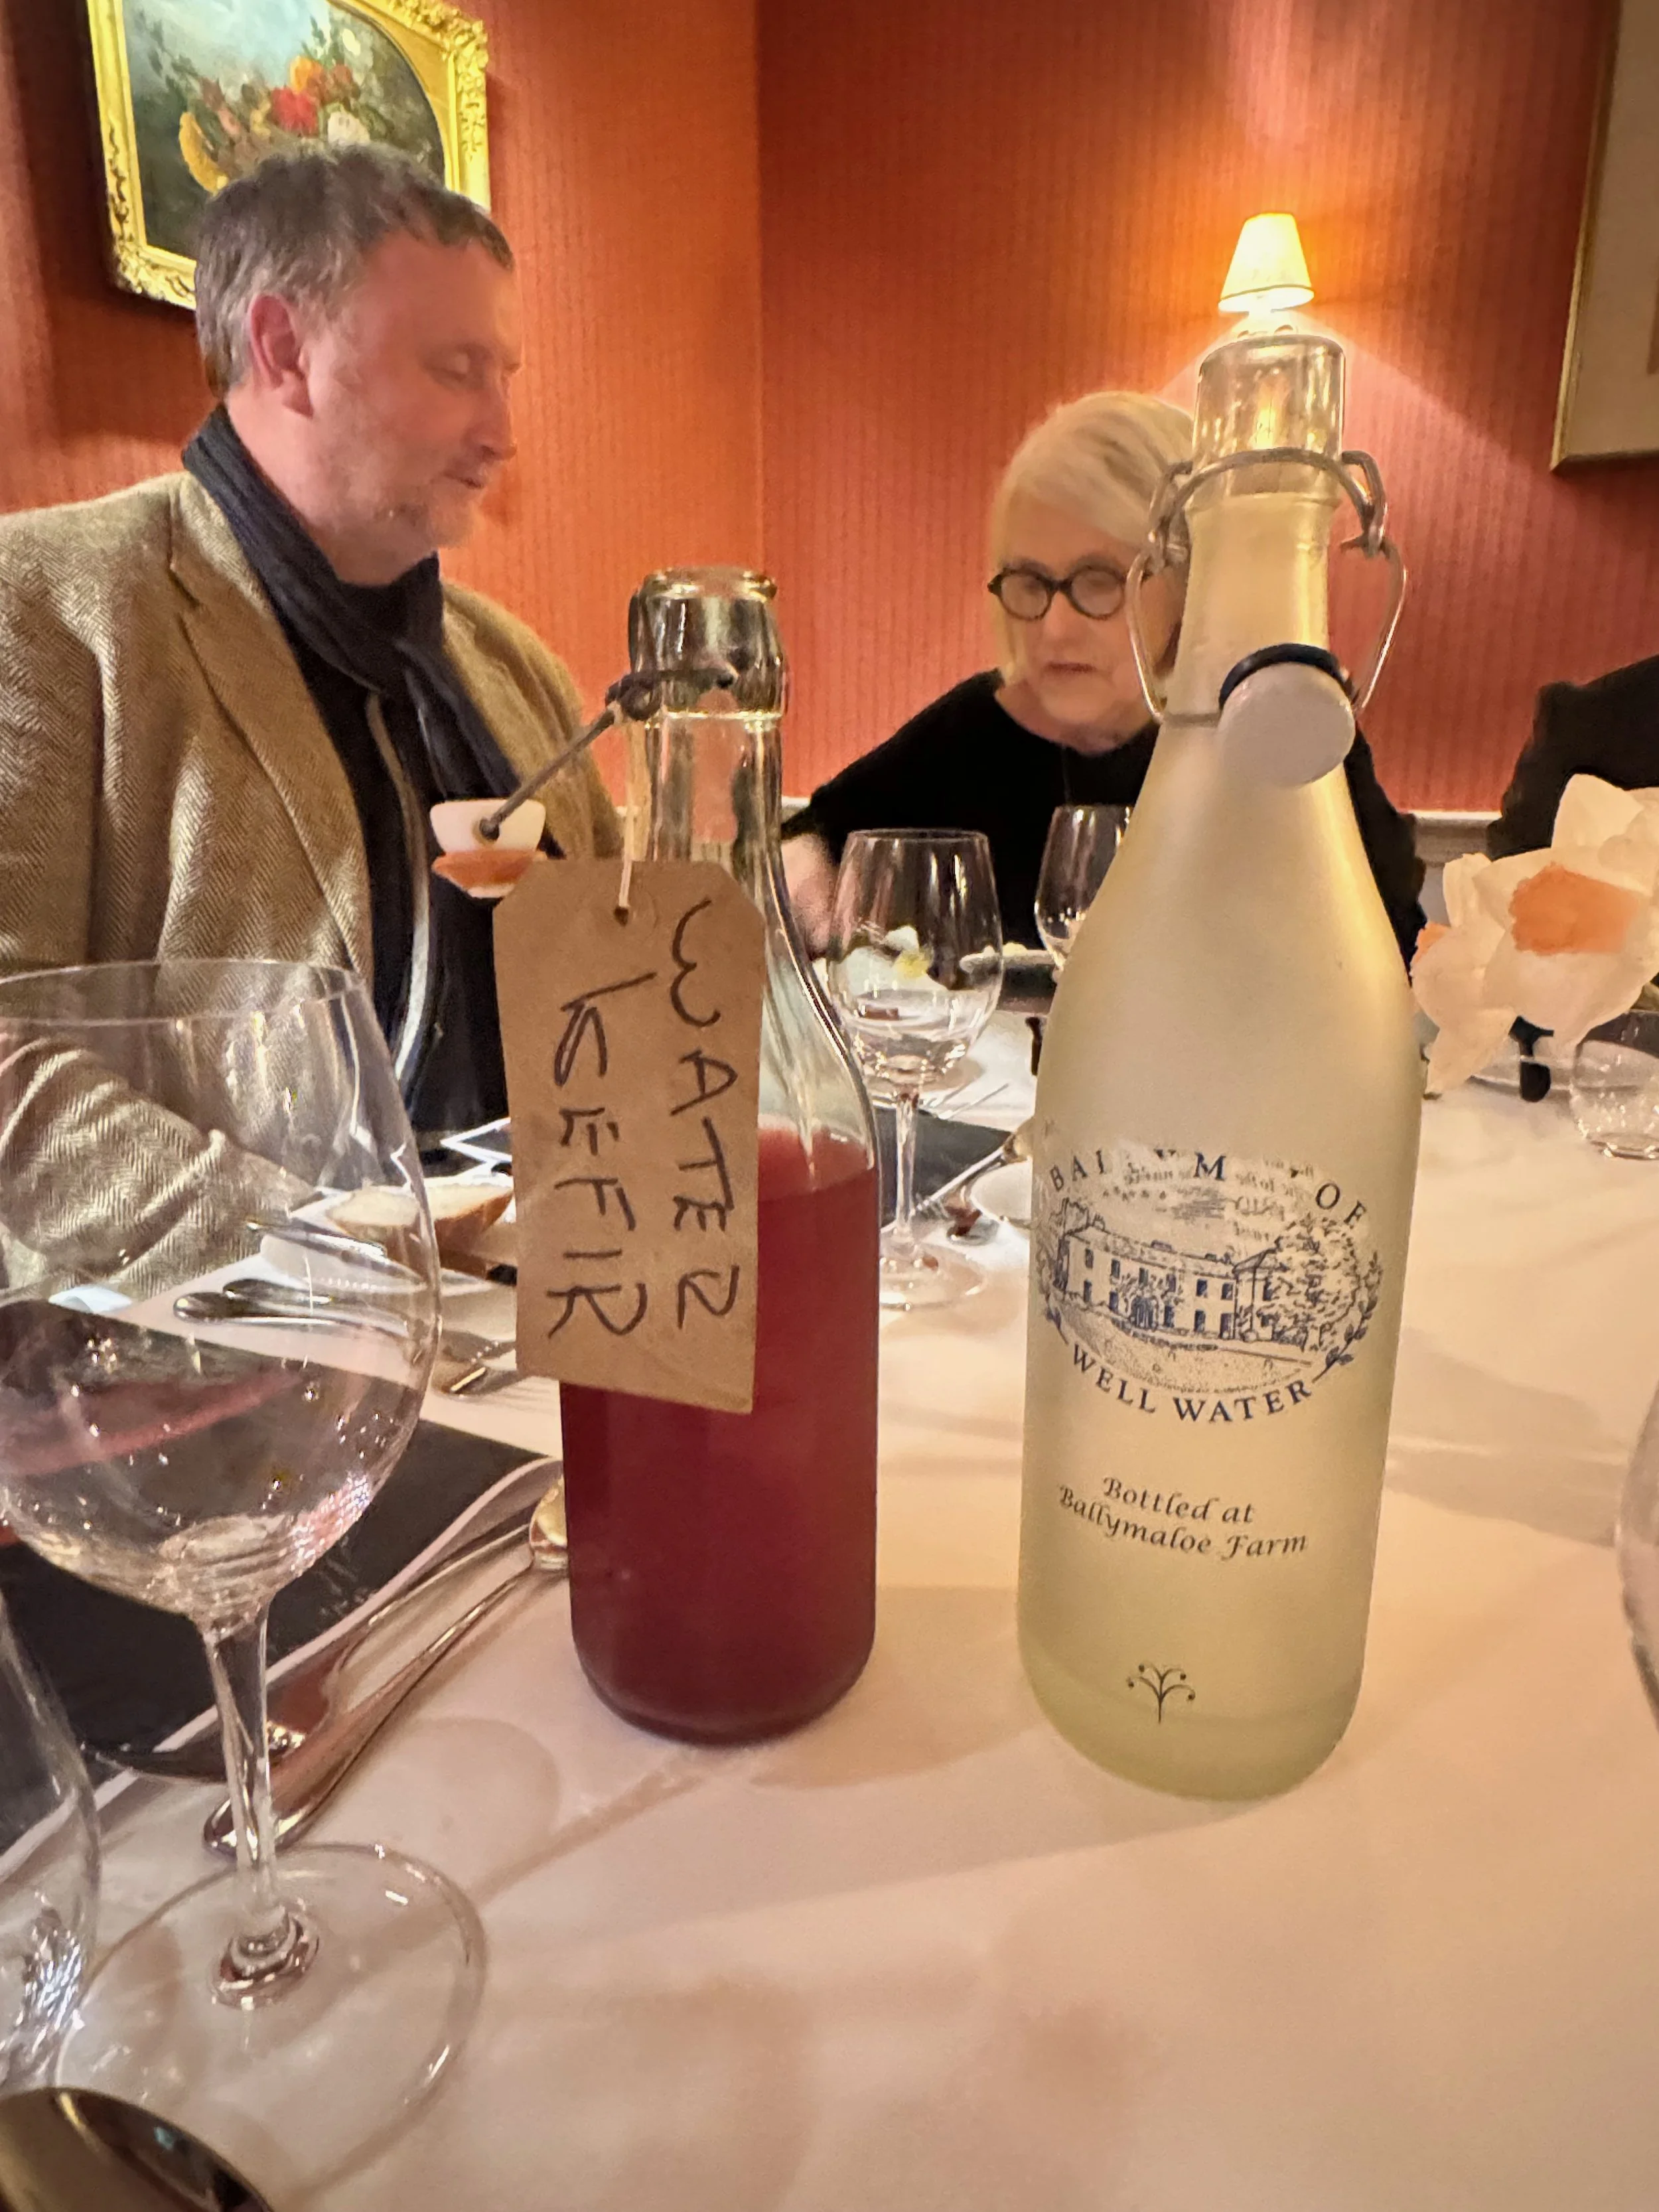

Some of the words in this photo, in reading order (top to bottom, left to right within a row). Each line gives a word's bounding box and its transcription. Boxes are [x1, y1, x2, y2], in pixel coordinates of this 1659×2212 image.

[670, 896, 740, 1329] WATER
[545, 971, 658, 1339] KEFIR
[1072, 1344, 1157, 1414] WELL
[1172, 1380, 1313, 1423] WATER
[1059, 1484, 1212, 1554] Ballymaloe
[1220, 1534, 1307, 1561] Farm
[1103, 1477, 1220, 1520] Bottled
[1221, 1503, 1255, 1523] at
